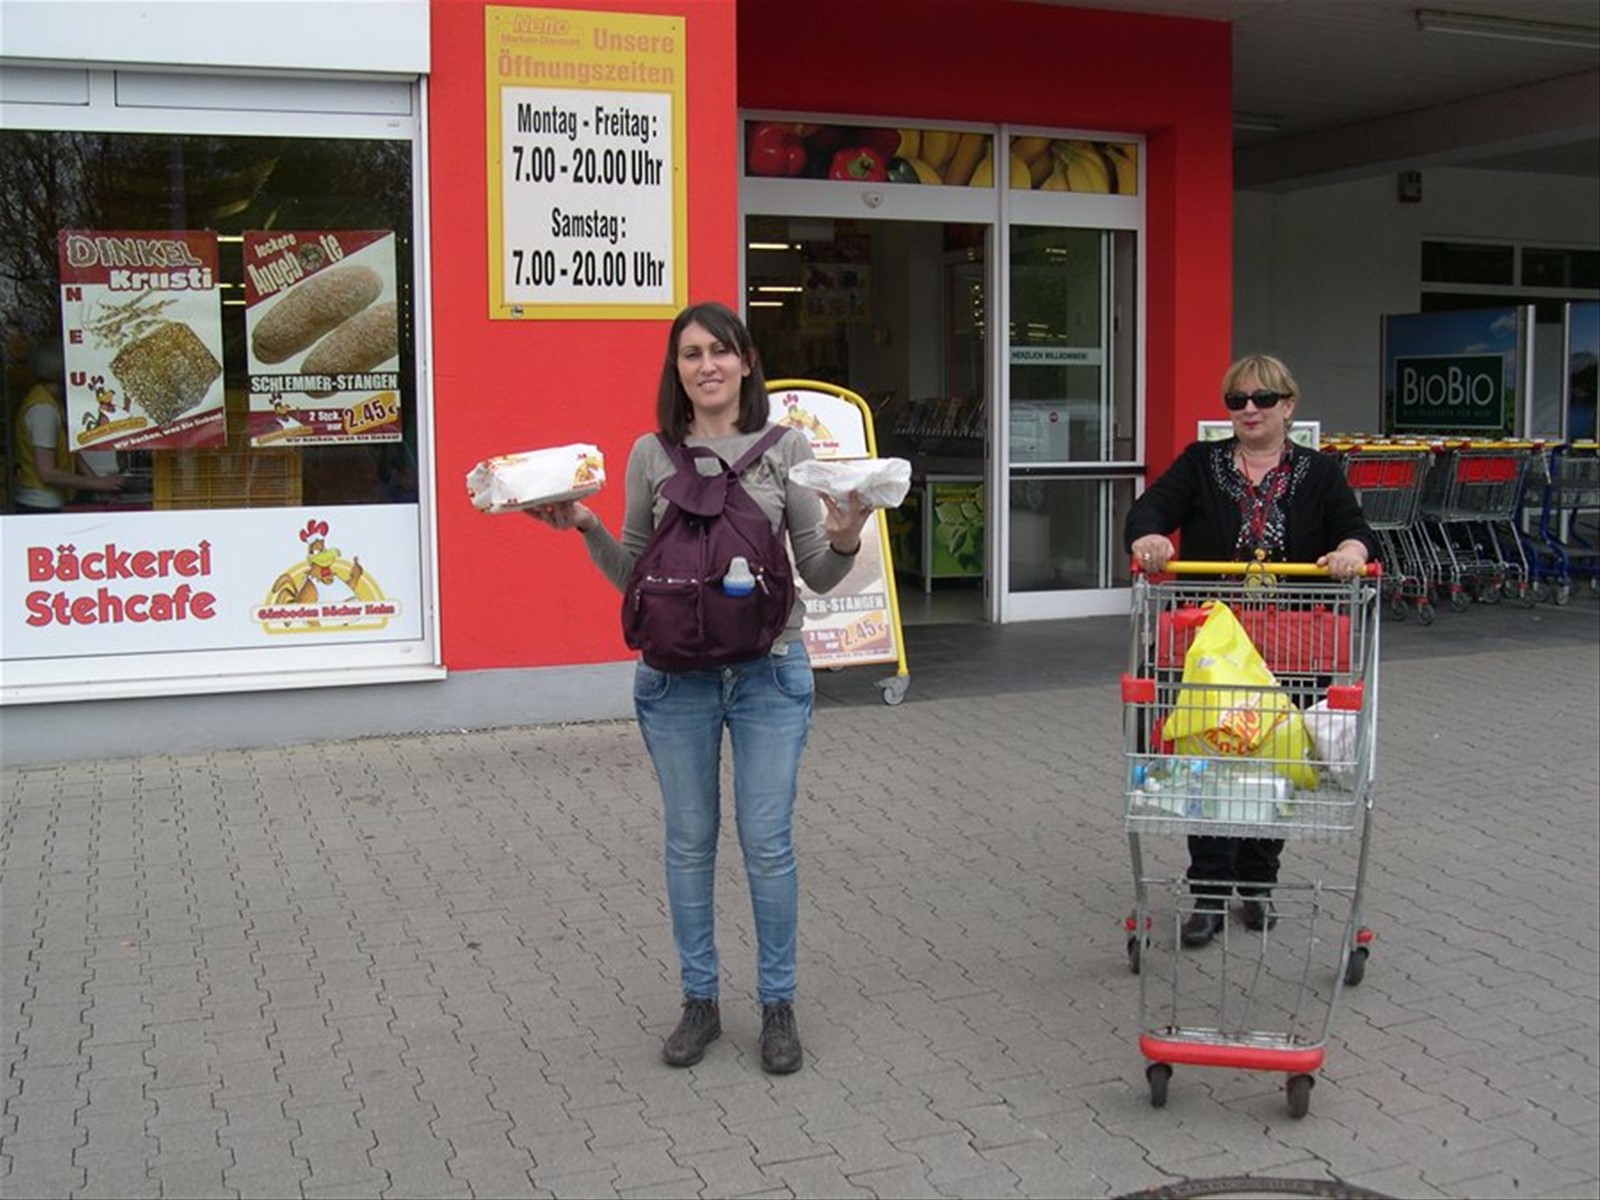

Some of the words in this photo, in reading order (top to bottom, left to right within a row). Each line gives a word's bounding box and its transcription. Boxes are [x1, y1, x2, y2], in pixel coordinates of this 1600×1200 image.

[592, 28, 675, 54] Unsere
[498, 48, 675, 85] Öffnungszeiten
[517, 103, 577, 141] Montag
[595, 106, 657, 143] Freitag:
[513, 146, 555, 183] 7.00
[572, 148, 627, 185] 20.00
[632, 150, 663, 185] Uhr
[551, 207, 626, 245] Samstag:
[66, 235, 203, 267] DINKEL
[513, 250, 555, 286] 7.00
[572, 251, 627, 287] 20.00
[633, 252, 665, 287] Uhr
[109, 267, 213, 291] Krusti
[251, 374, 398, 392] SCHLEMMER-STANGEN
[308, 411, 316, 422] 2
[26, 539, 212, 582] Bäckerei
[25, 584, 217, 627] Stehcafe
